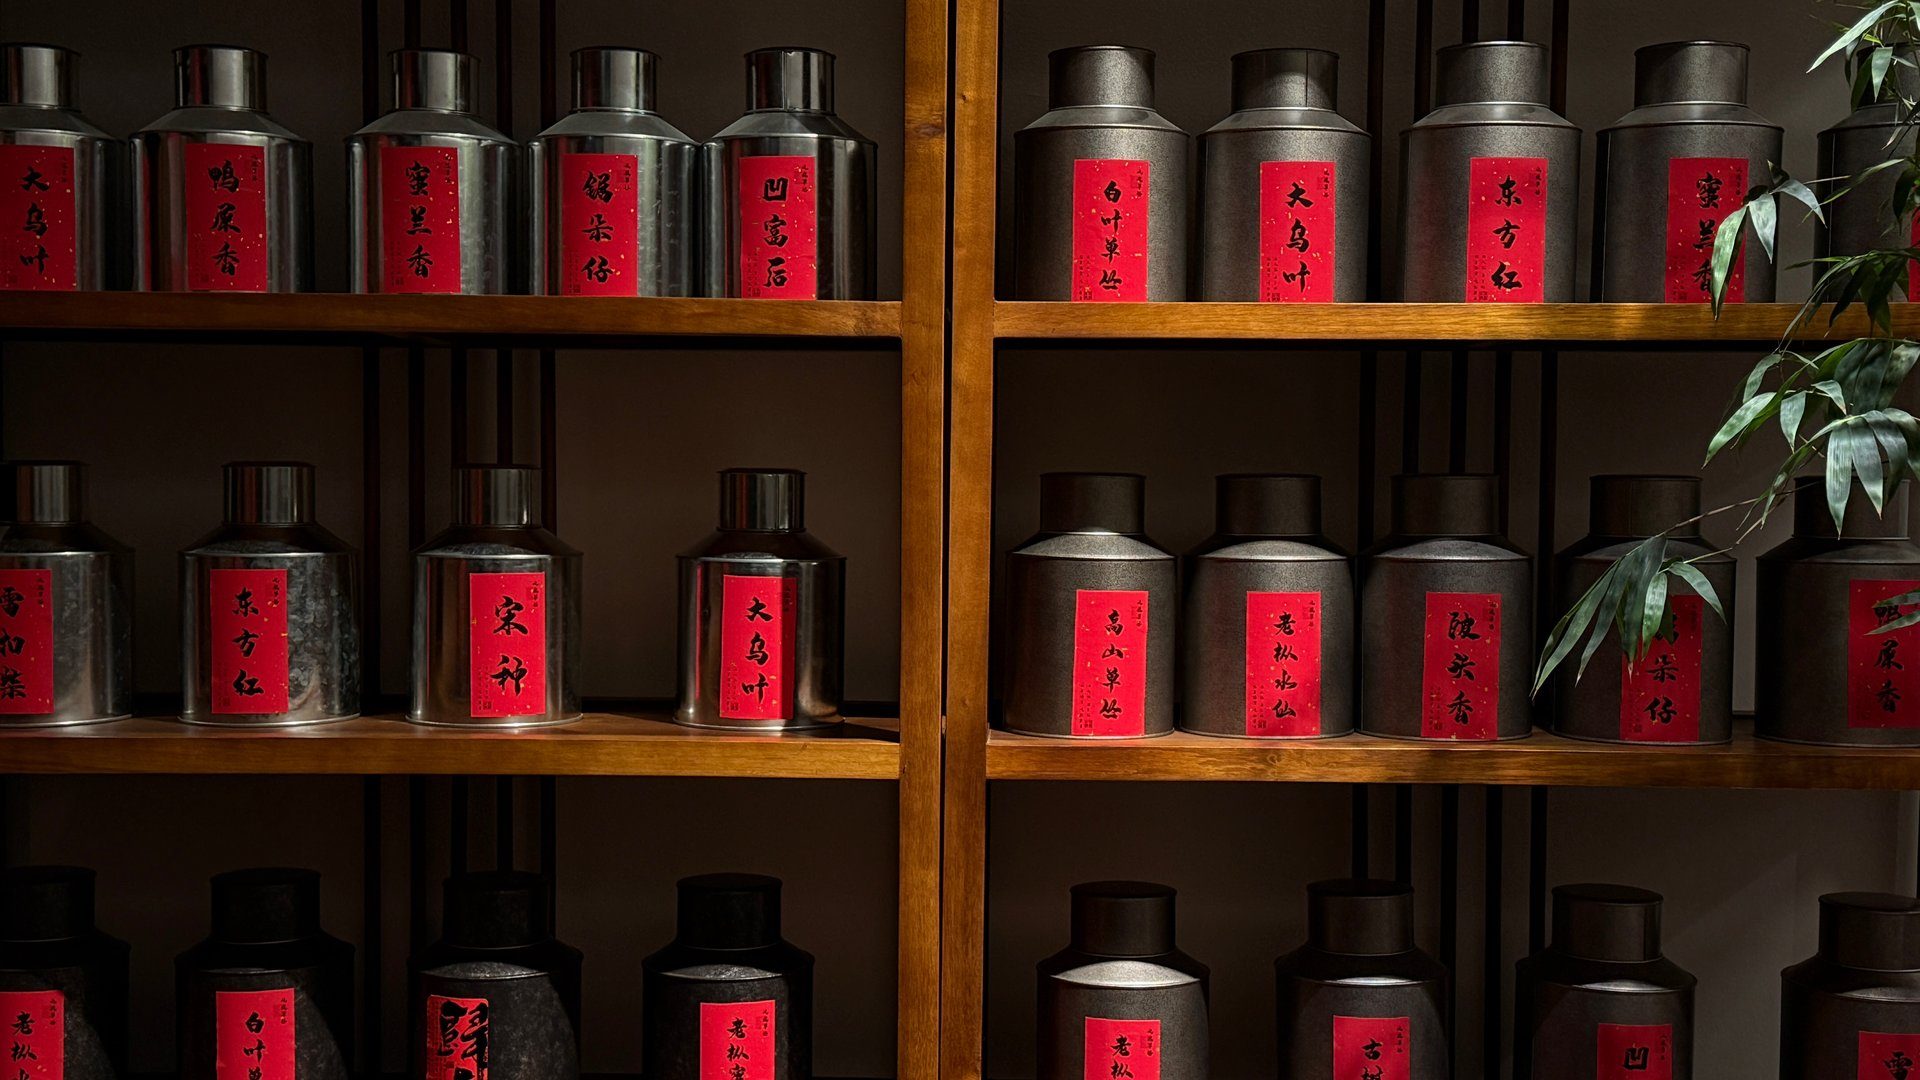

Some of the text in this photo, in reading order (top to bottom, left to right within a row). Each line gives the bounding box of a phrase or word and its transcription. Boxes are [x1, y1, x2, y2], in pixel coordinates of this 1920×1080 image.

[1282, 182, 1313, 292] 大乌叶
[1491, 175, 1522, 290] 东方红
[233, 587, 264, 696] 东方红
[742, 597, 773, 704] 大乌叶
